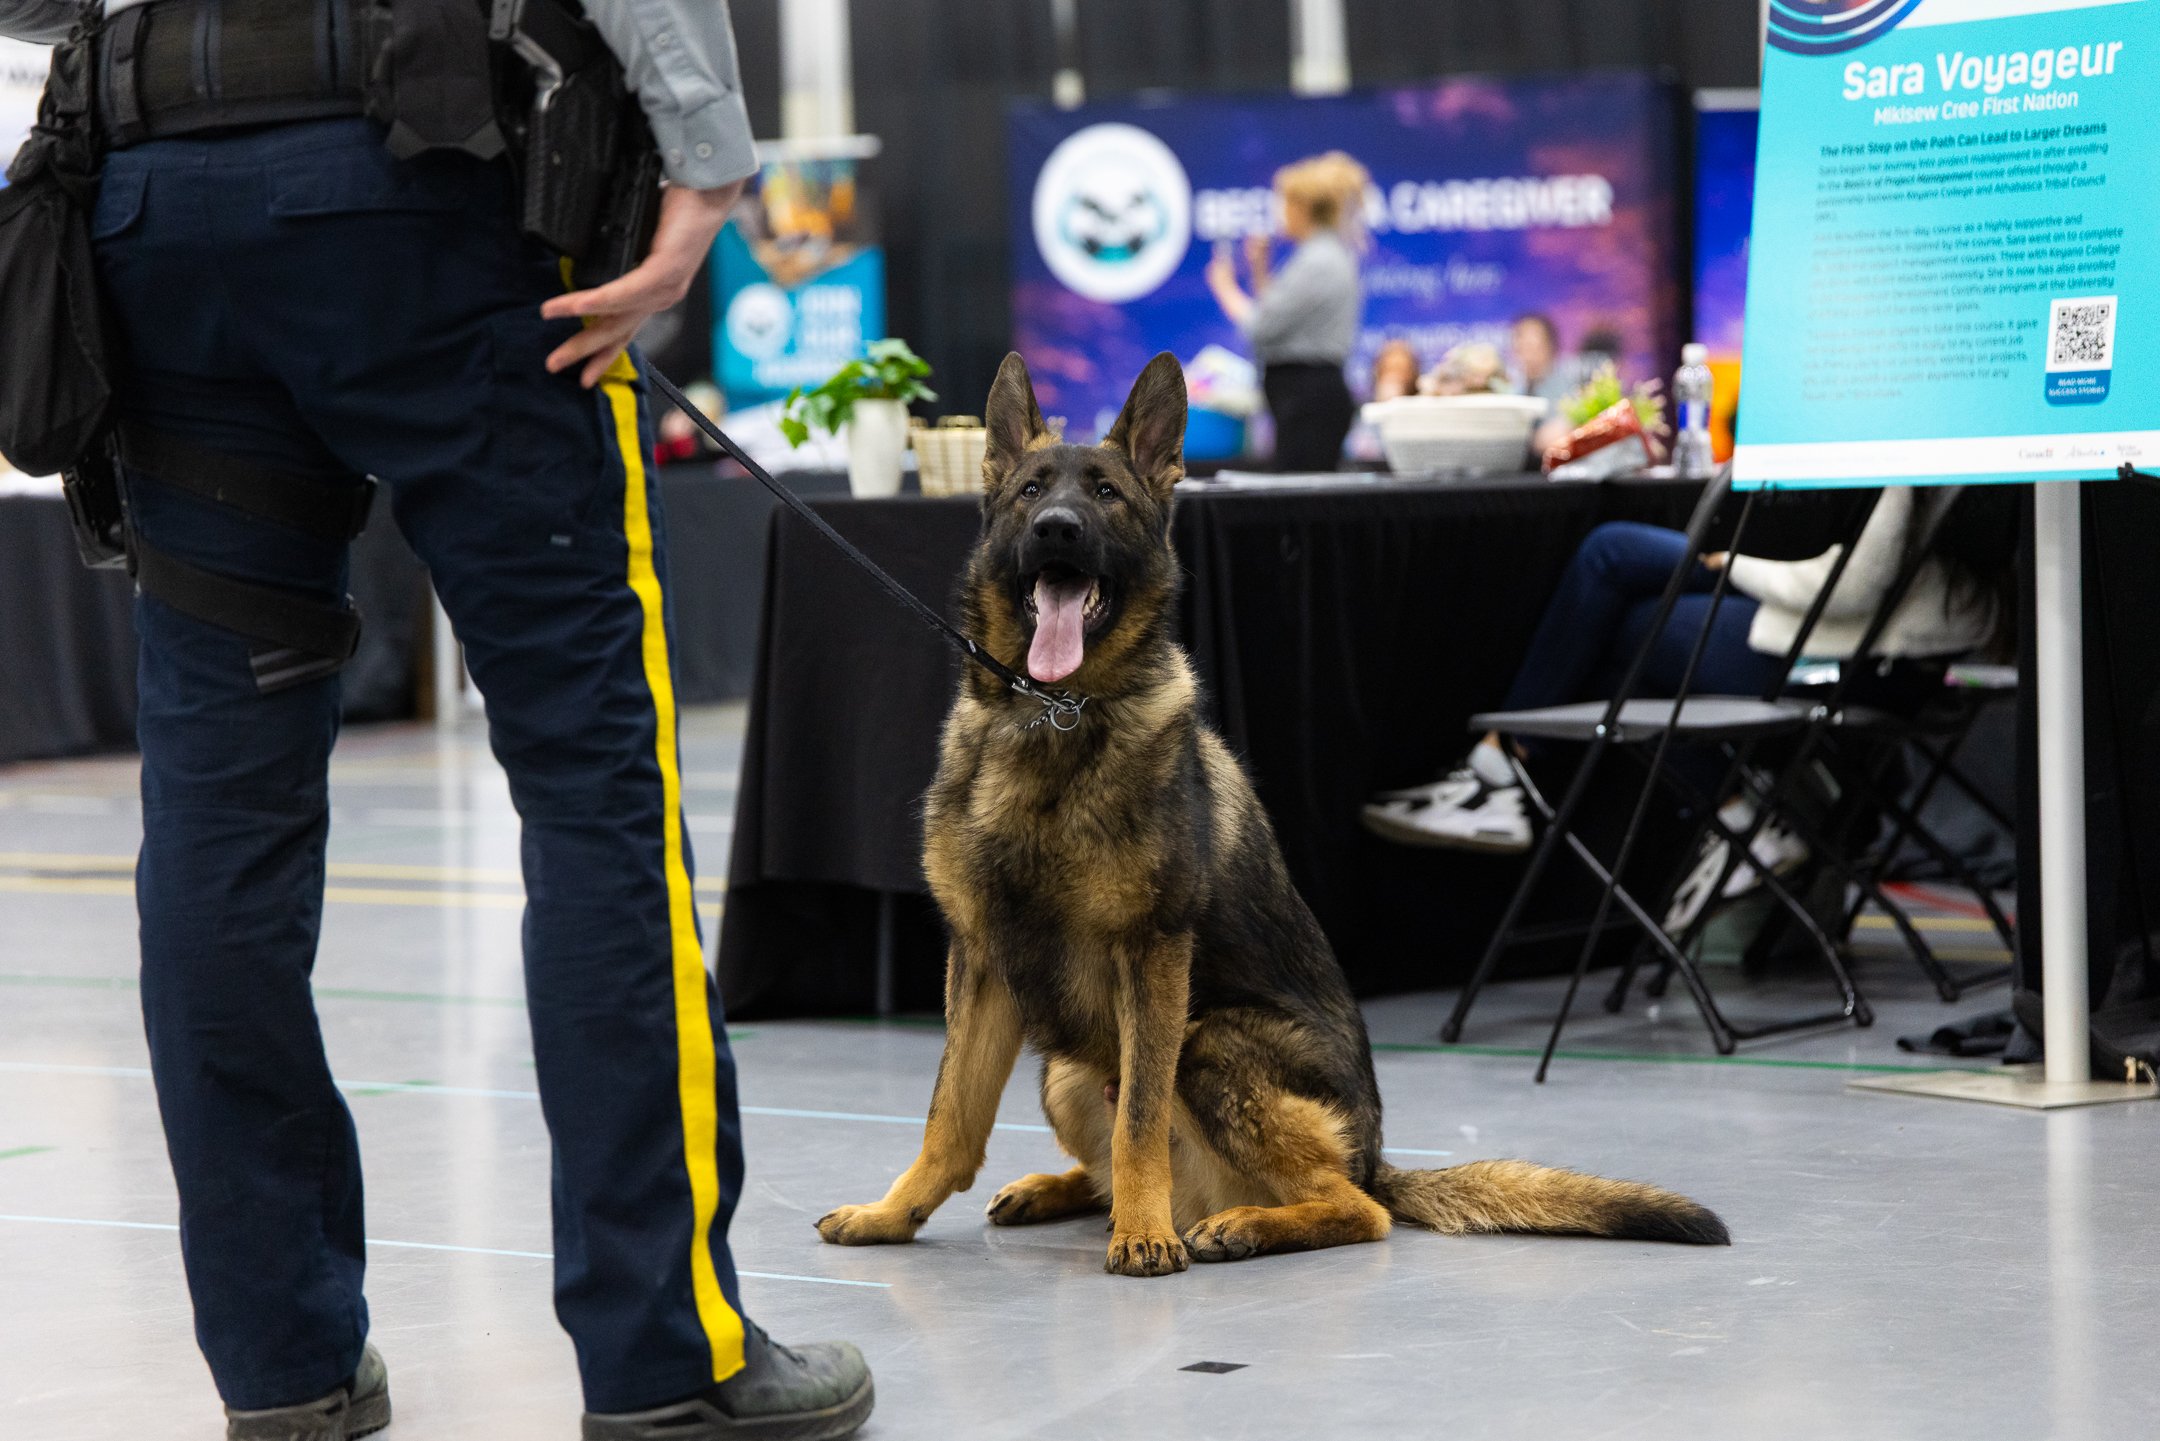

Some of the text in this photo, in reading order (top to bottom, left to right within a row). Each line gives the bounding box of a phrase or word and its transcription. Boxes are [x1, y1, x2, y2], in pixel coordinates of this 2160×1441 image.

[1842, 41, 2123, 100] Sara Voyageur
[1874, 90, 2079, 126] Mikisew Cree First Nation
[1819, 122, 2107, 157] The First Step on the Path Can Lead to Larger Dreams
[1937, 154, 1968, 168] project
[1970, 149, 2030, 165] management
[2043, 146, 2065, 158] after
[2067, 142, 2109, 156] enrolling
[1884, 174, 1915, 188] Project
[1917, 169, 1973, 184] Management
[1974, 167, 2005, 179] course
[2007, 163, 2040, 177] offered
[2042, 160, 2078, 174] through
[1975, 183, 1993, 196] and
[2044, 177, 2069, 190] Tribal
[2071, 173, 2106, 188] Council
[2064, 212, 2083, 225] and
[2005, 233, 2026, 247] Sara
[2028, 231, 2051, 245] went
[2079, 226, 2123, 241] complete
[2050, 245, 2083, 260] Keyano
[2085, 242, 2120, 257] College
[2037, 262, 2054, 275] has
[2056, 260, 2075, 274] also
[2077, 258, 2116, 272] enrolled
[2067, 275, 2115, 291] University
